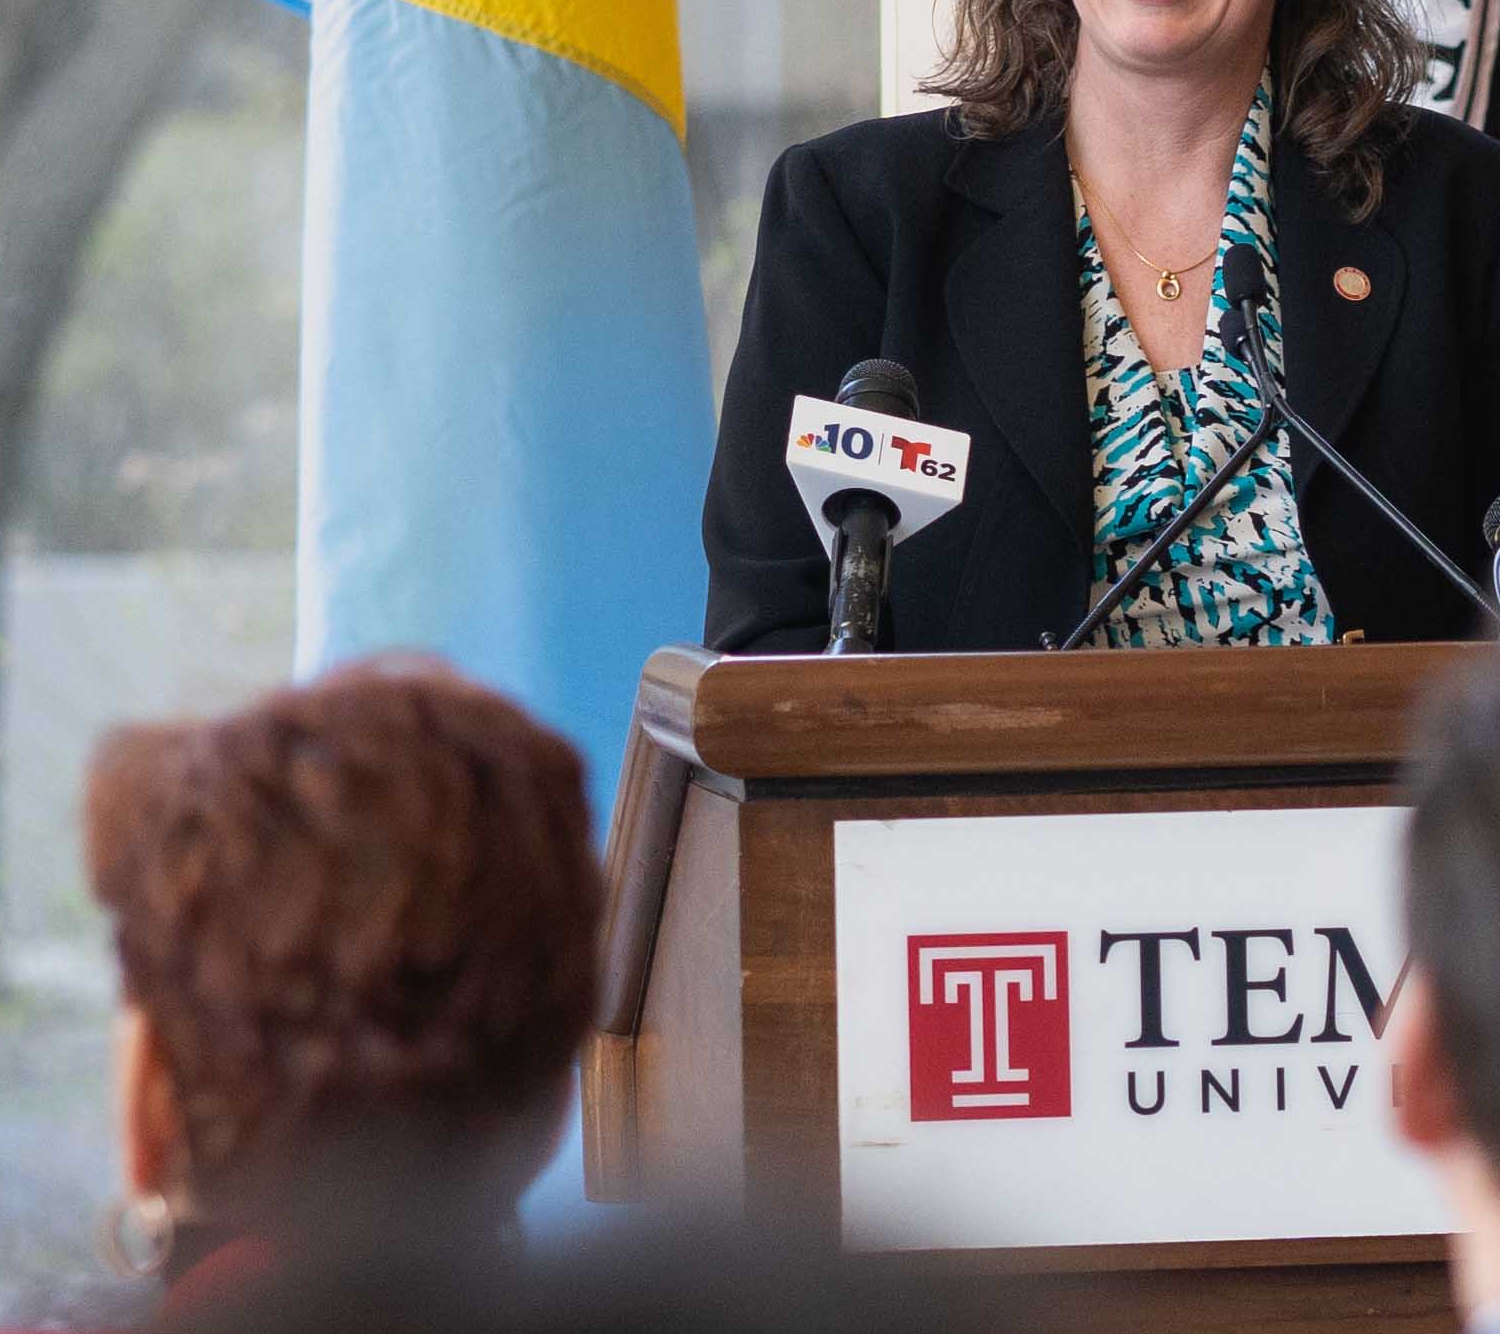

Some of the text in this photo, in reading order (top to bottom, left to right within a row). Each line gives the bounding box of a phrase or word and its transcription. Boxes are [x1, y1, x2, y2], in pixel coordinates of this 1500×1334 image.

[824, 423, 874, 460] 10
[920, 459, 957, 482] 62
[1099, 926, 1414, 1049] TEM
[1127, 1064, 1406, 1116] UNIV
